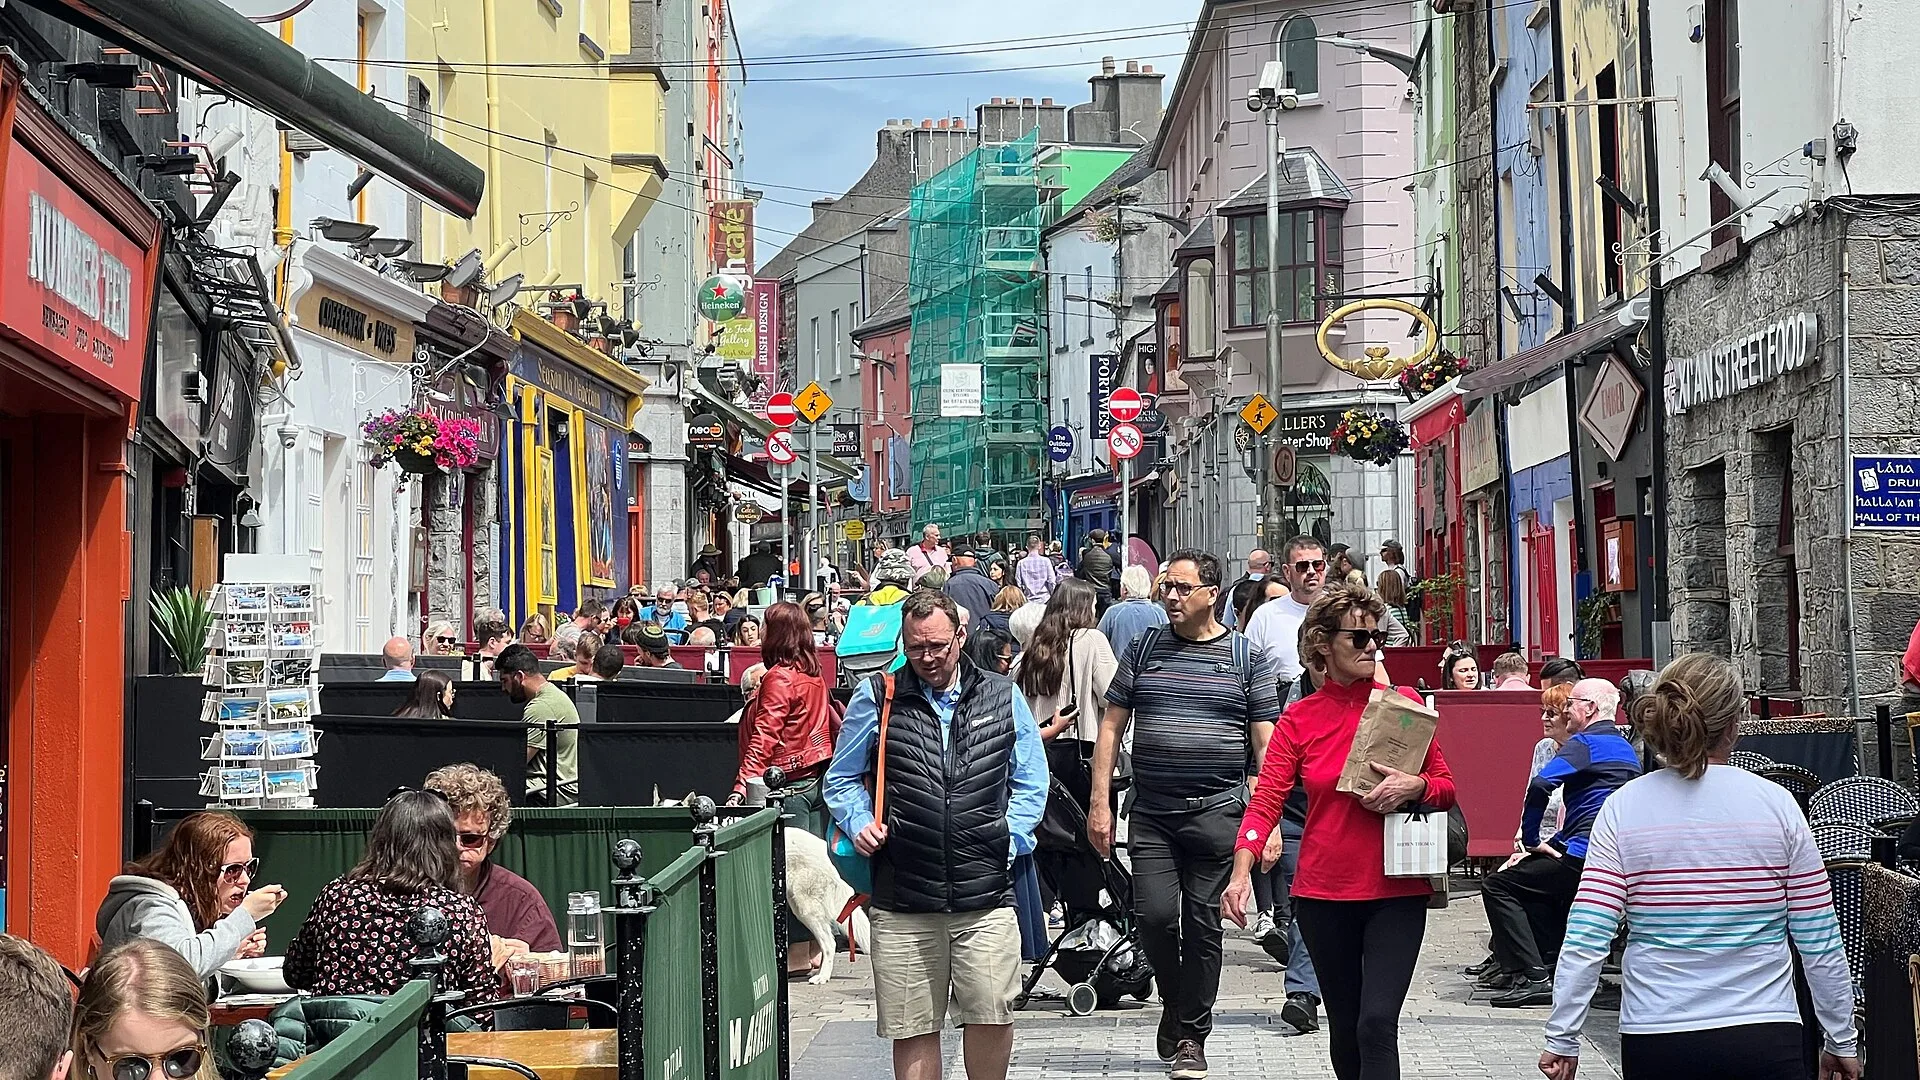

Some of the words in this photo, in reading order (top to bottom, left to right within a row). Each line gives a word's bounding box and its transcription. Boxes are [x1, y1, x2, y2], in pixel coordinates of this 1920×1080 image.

[28, 190, 100, 321] NUMBER
[101, 248, 131, 341] TEN
[701, 301, 740, 311] Heineken
[759, 292, 769, 331] DESIGN
[735, 322, 753, 334] Food
[374, 320, 397, 354] PRESS
[720, 334, 750, 348] Gallery
[759, 333, 769, 366] IRISH
[1678, 350, 1714, 408] XI'AN
[1715, 330, 1765, 399] STREET
[1768, 311, 1807, 378] FOOD
[1282, 415, 1326, 431] LLER'S
[834, 444, 858, 452] ISTRO
[1305, 432, 1332, 450] Shop
[1053, 446, 1068, 454] Shop
[1888, 478, 1920, 487] DRUI
[1855, 512, 1884, 522] HALL
[1886, 513, 1902, 522] OF
[1904, 513, 1920, 521] TH
